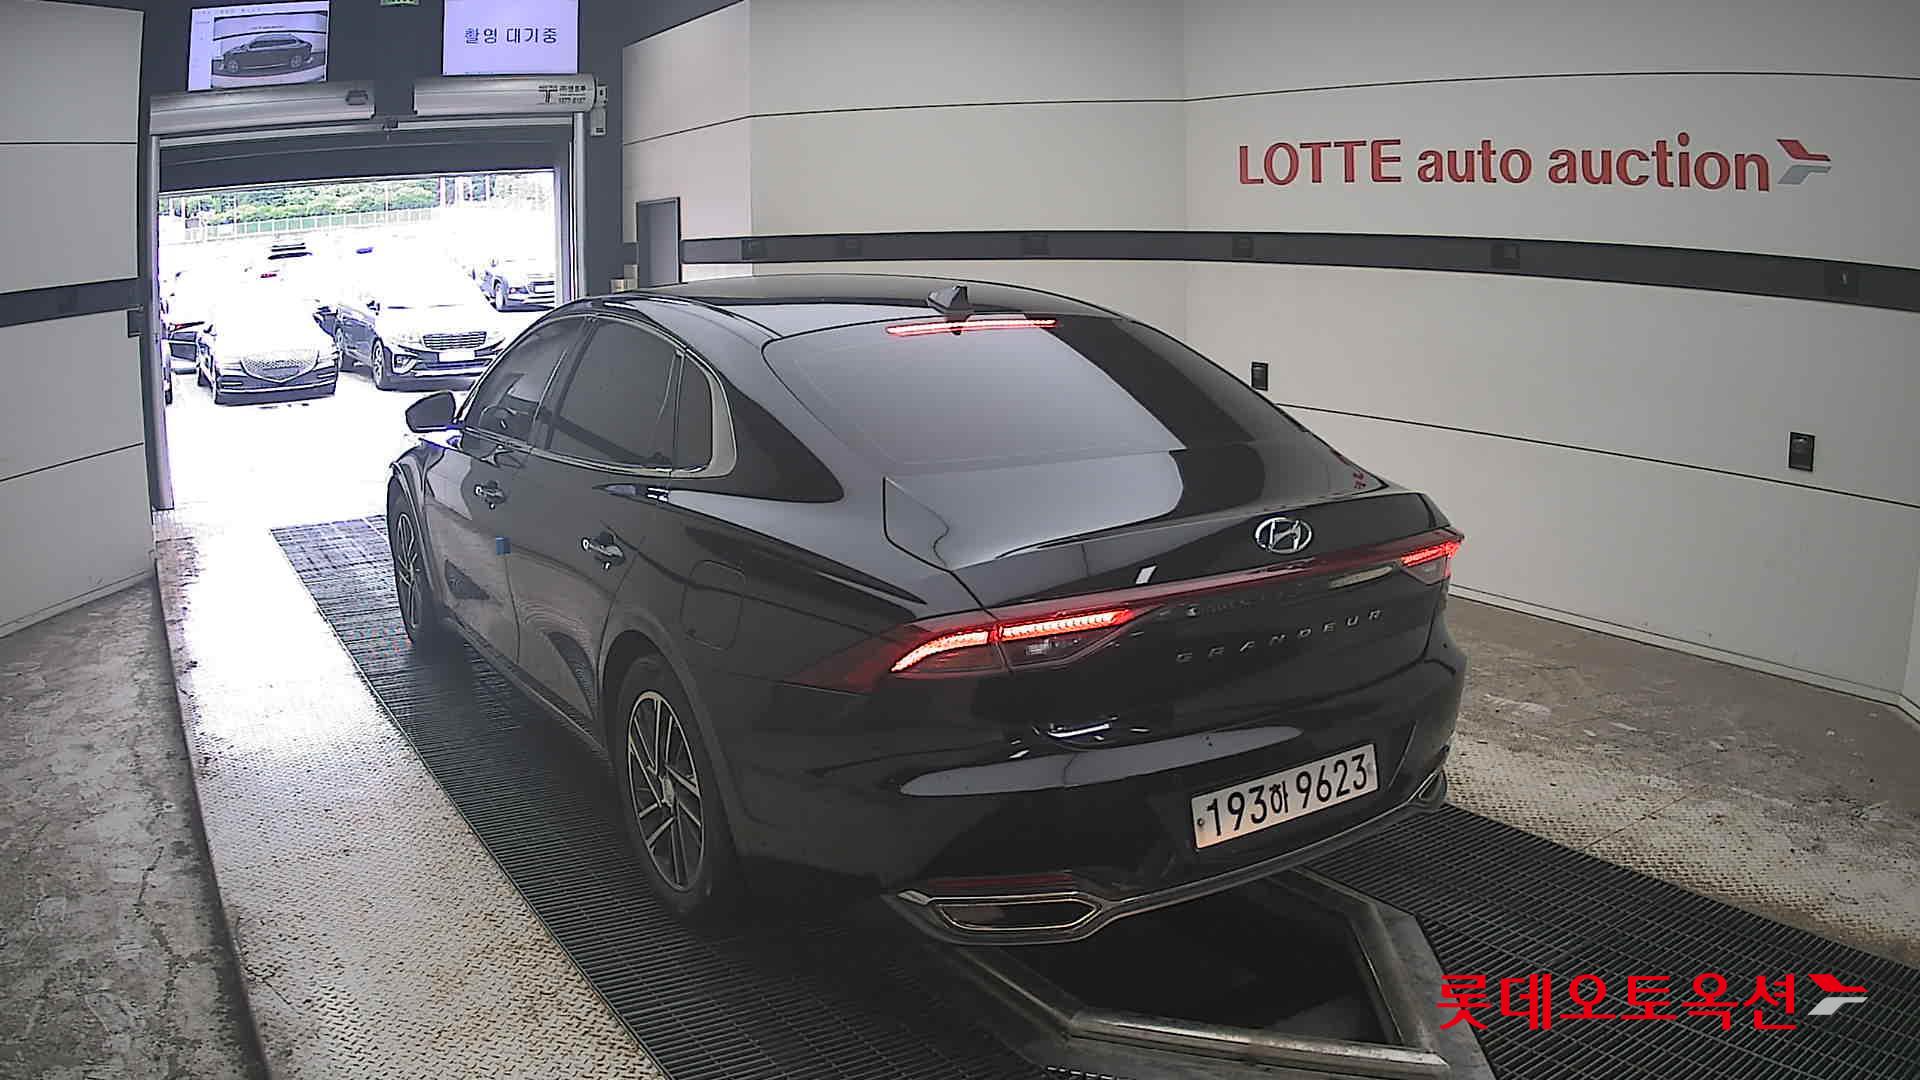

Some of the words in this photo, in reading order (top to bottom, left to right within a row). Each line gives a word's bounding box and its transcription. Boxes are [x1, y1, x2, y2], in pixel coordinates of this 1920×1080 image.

[1239, 138, 1402, 185] LOTTE
[1417, 139, 1532, 184] auto
[1547, 132, 1770, 191] auction
[1206, 780, 1289, 837] 193하
[1295, 753, 1368, 809] 9623
